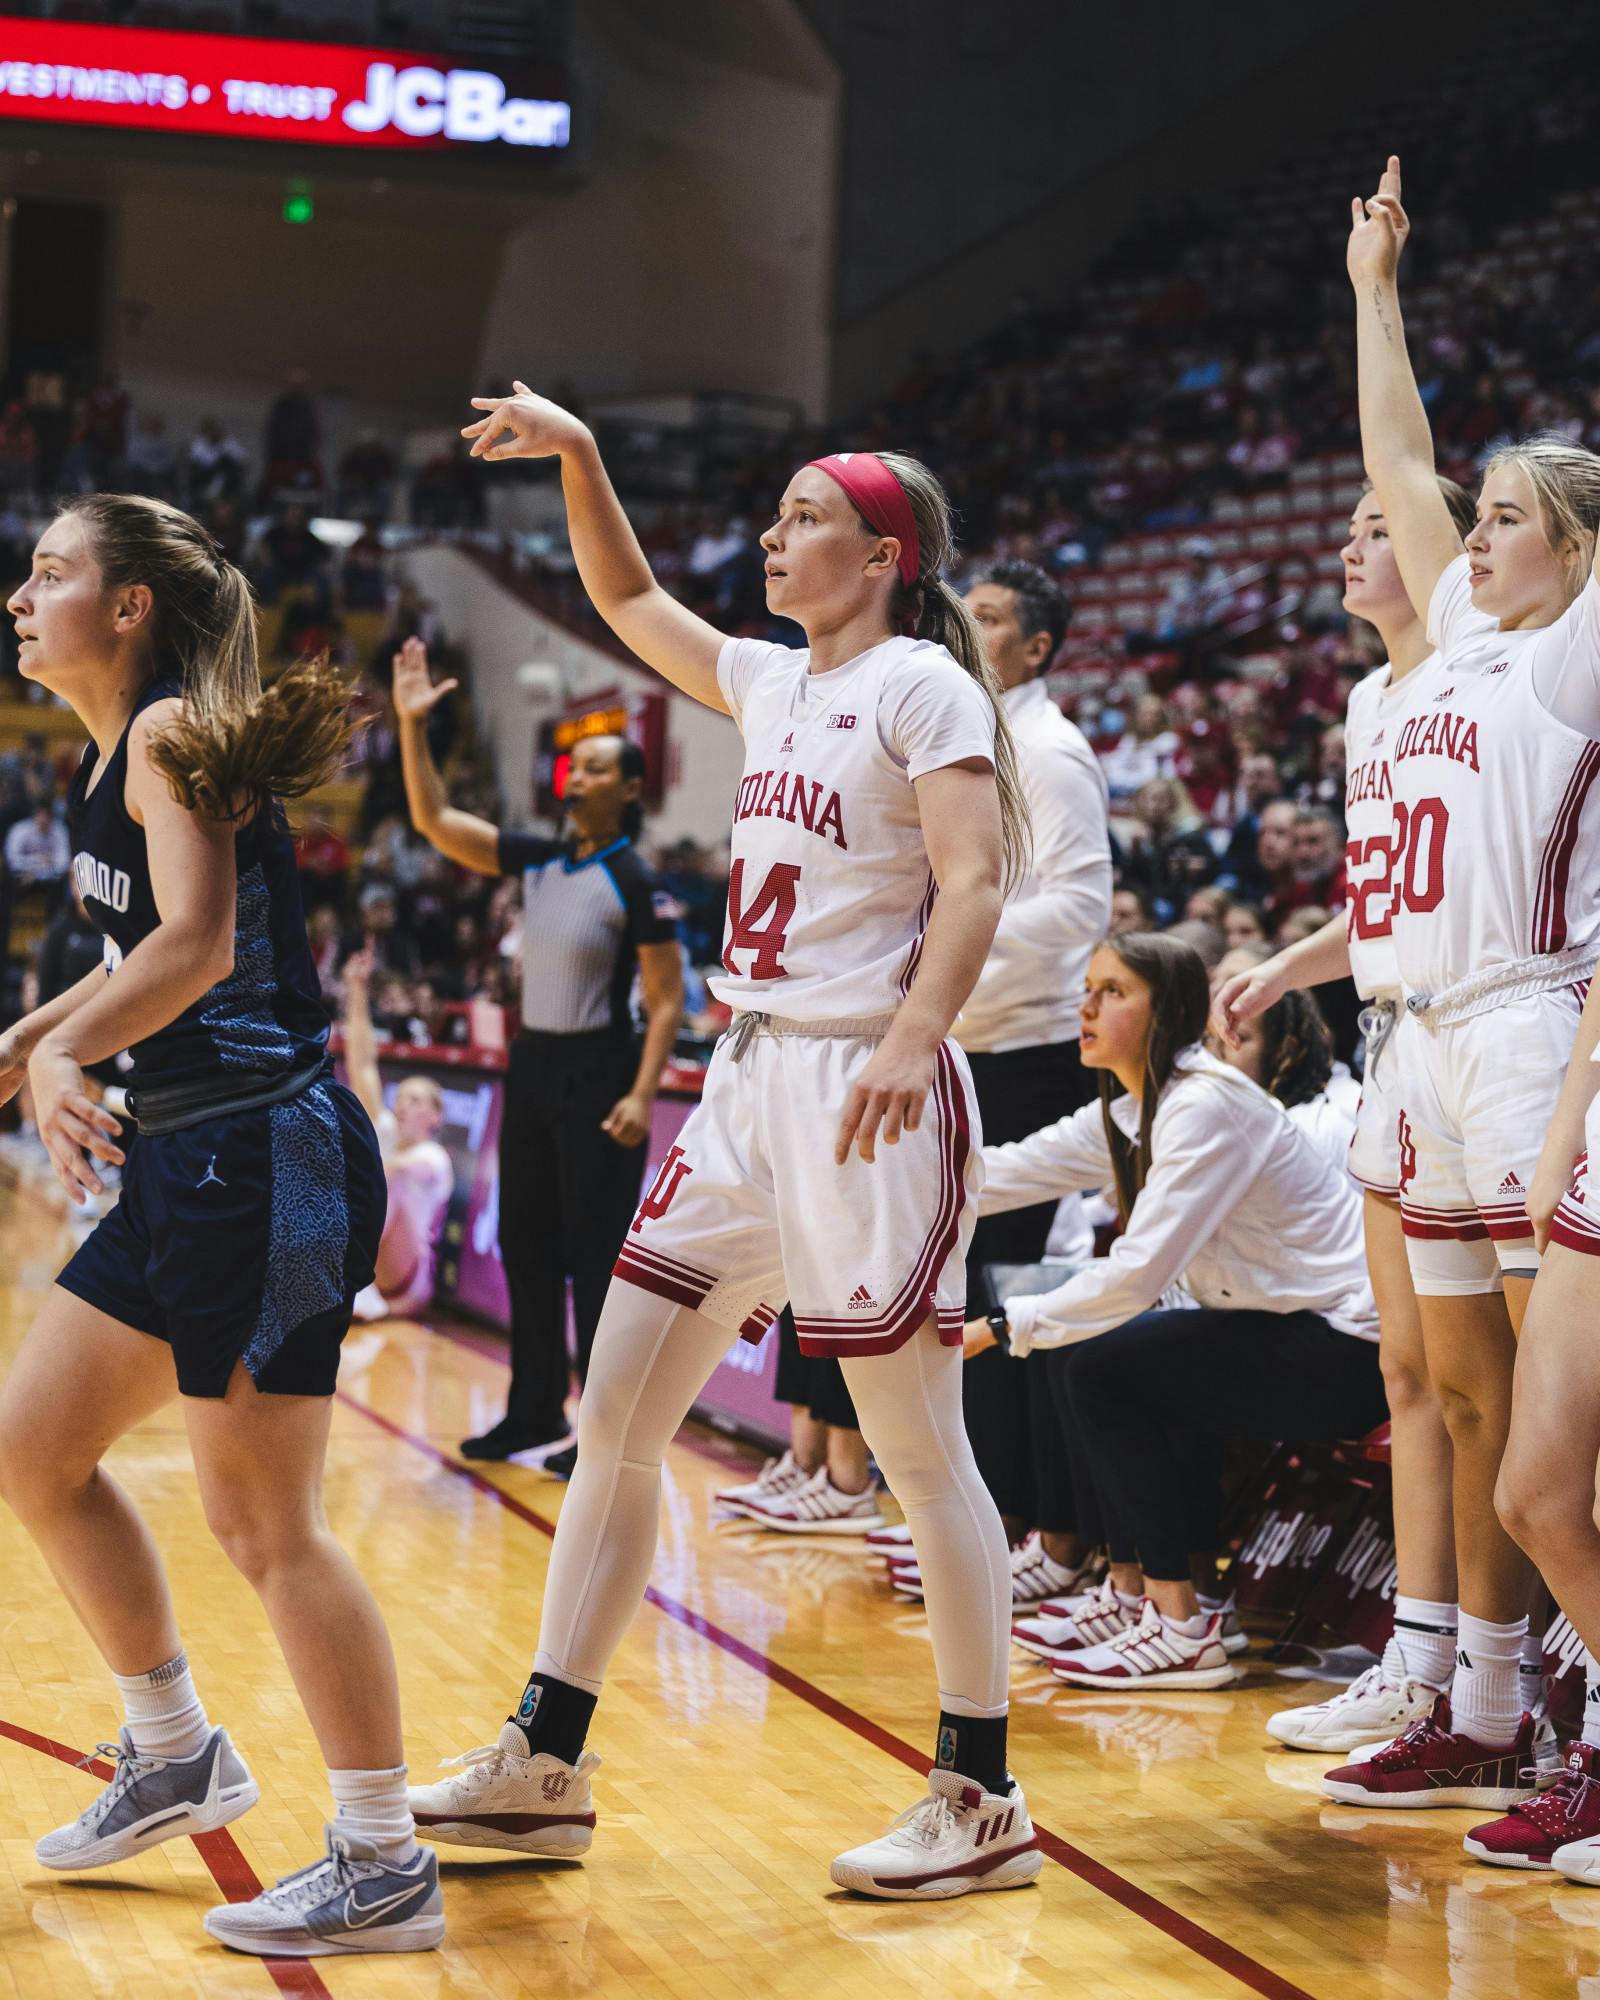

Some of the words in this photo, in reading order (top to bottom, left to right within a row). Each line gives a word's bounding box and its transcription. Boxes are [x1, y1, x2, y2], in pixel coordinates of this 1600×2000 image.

[221, 79, 338, 121] TRUST
[723, 858, 802, 981] 14
[1497, 1185, 1526, 1195] adidas
[847, 1299, 878, 1310] adidas
